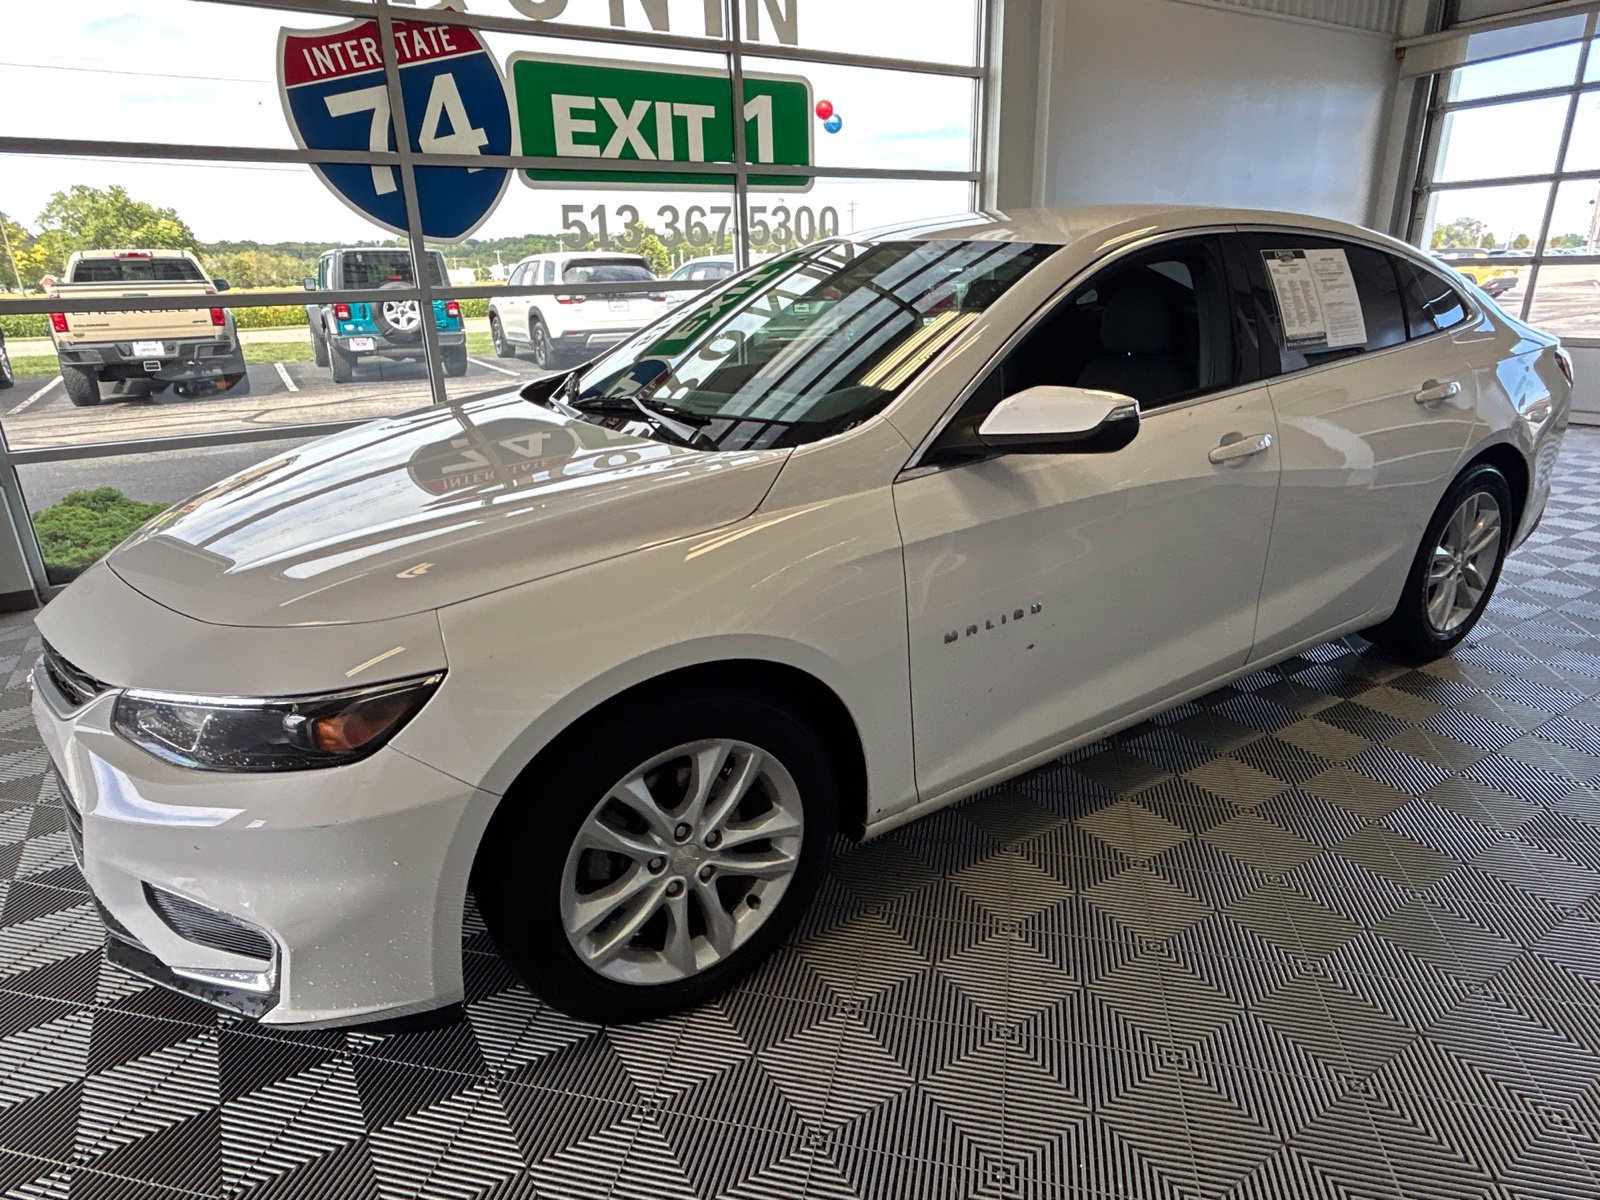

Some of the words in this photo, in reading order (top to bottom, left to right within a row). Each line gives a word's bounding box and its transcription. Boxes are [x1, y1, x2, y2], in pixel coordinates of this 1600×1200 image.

[303, 25, 457, 77] INTERTATE
[323, 72, 489, 196] 74
[551, 93, 716, 163] EXIT
[743, 94, 775, 164] 1
[943, 601, 1043, 645] MALIBU
